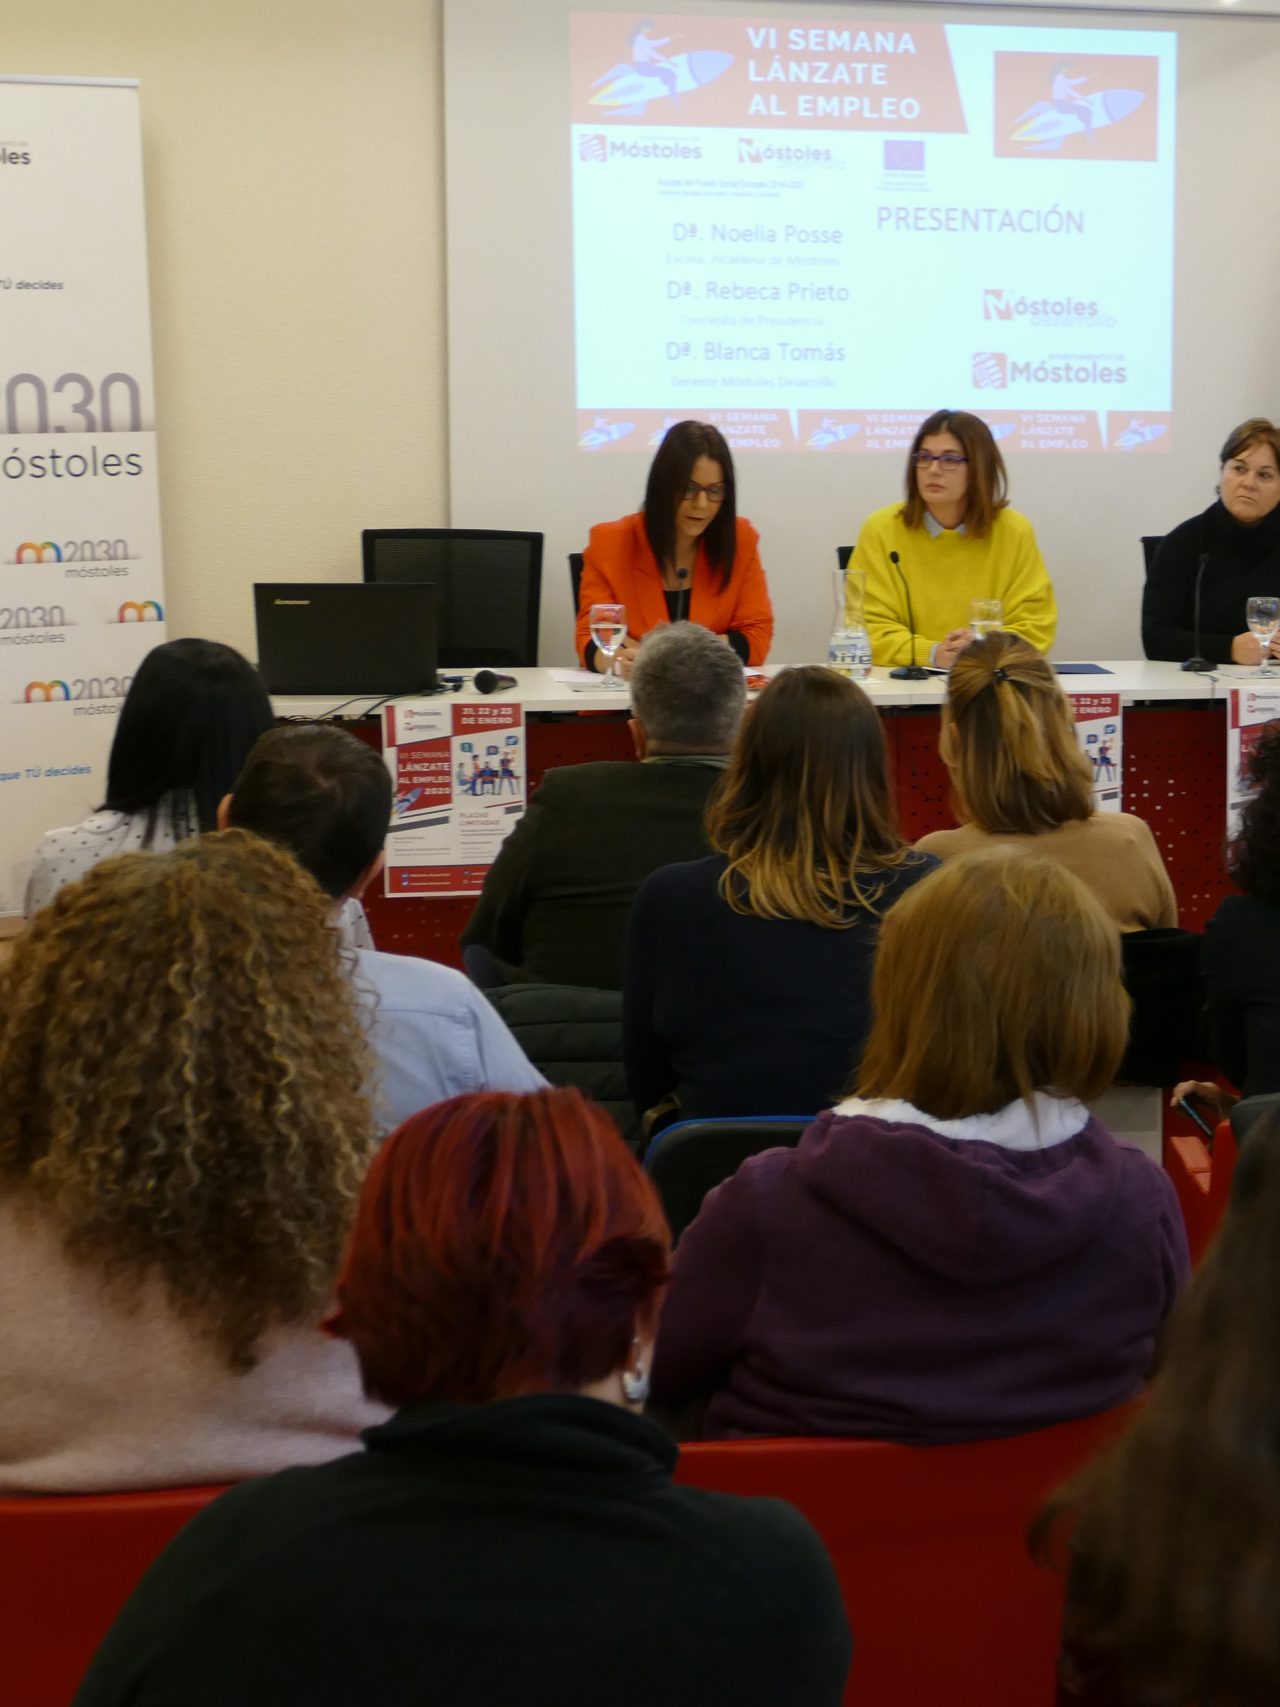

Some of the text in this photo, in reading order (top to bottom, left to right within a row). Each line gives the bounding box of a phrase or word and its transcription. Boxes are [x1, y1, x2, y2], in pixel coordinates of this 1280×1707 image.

[746, 27, 918, 55] VI SEMANA
[748, 55, 889, 86] LÁNZATE
[747, 94, 921, 120] AL EMPLEO
[0, 146, 31, 166] les
[610, 141, 703, 160] Móstoles
[877, 203, 1085, 235] PRESENTACIÓN
[711, 223, 777, 243] Noelia
[785, 225, 843, 244] Posse
[16, 279, 65, 290] decides
[706, 281, 781, 301] Rebeca
[788, 283, 850, 302] Prieto
[983, 289, 1100, 321] Móstoles
[704, 341, 771, 361] Blanca
[778, 342, 846, 362] Tomás
[1011, 360, 1128, 384] Móstoles
[1037, 414, 1087, 425] SEMANA
[2, 445, 143, 479] óstoles
[64, 564, 129, 579] móstoles
[73, 702, 121, 717] móstol
[25, 766, 44, 780] TÚ
[45, 765, 92, 778] decides
[398, 761, 451, 773] LÁNZATE
